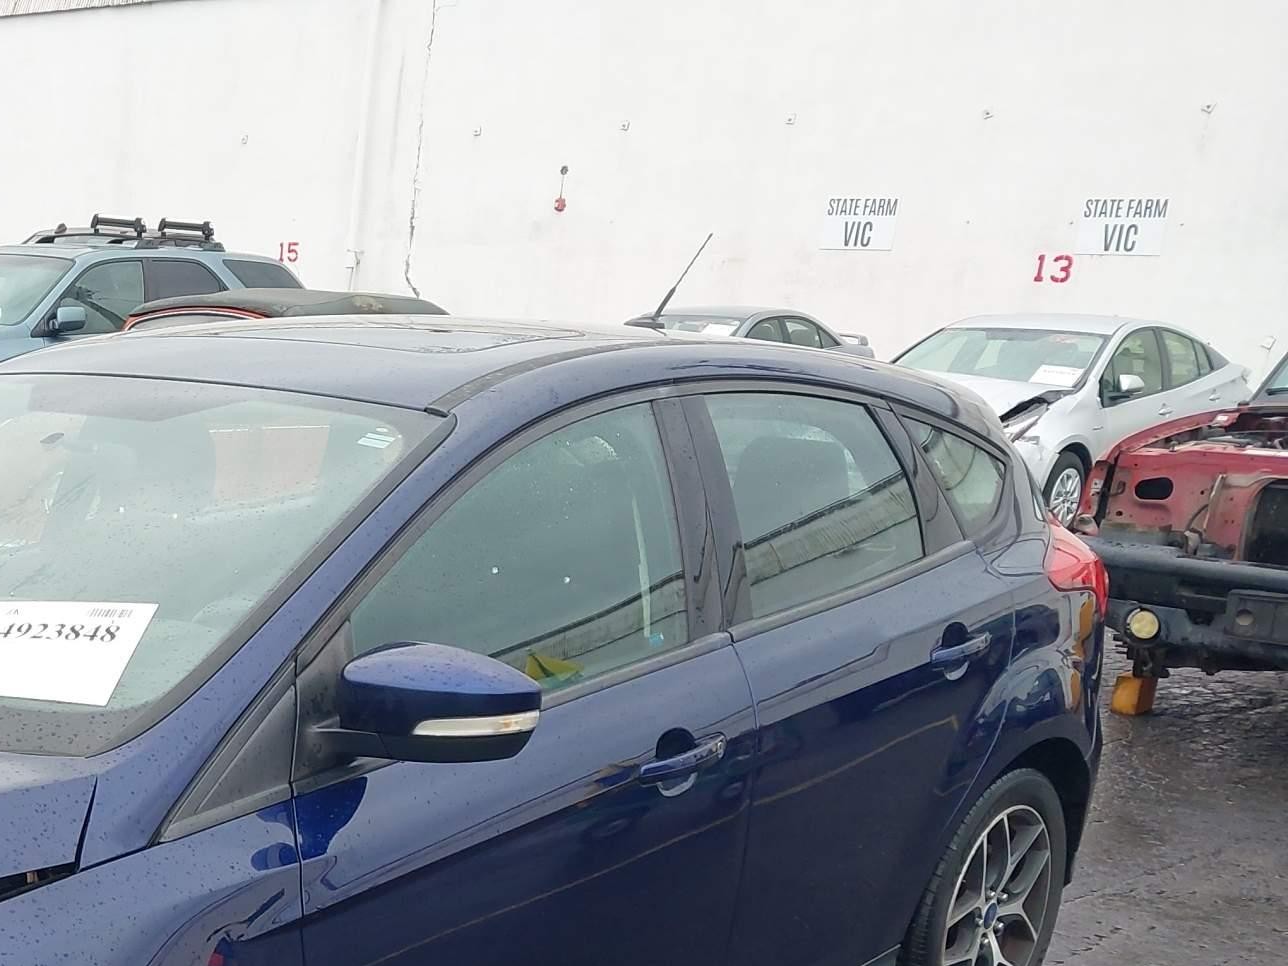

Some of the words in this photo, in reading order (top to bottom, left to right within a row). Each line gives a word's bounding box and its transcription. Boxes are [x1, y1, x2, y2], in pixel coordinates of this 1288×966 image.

[827, 198, 862, 216] STATE
[862, 198, 898, 216] FARM
[1083, 199, 1124, 218] STATE
[1126, 199, 1169, 218] FARM
[844, 221, 873, 247] VIC
[1103, 223, 1138, 252] VIC
[279, 242, 299, 263] 15
[1033, 254, 1073, 283] 13
